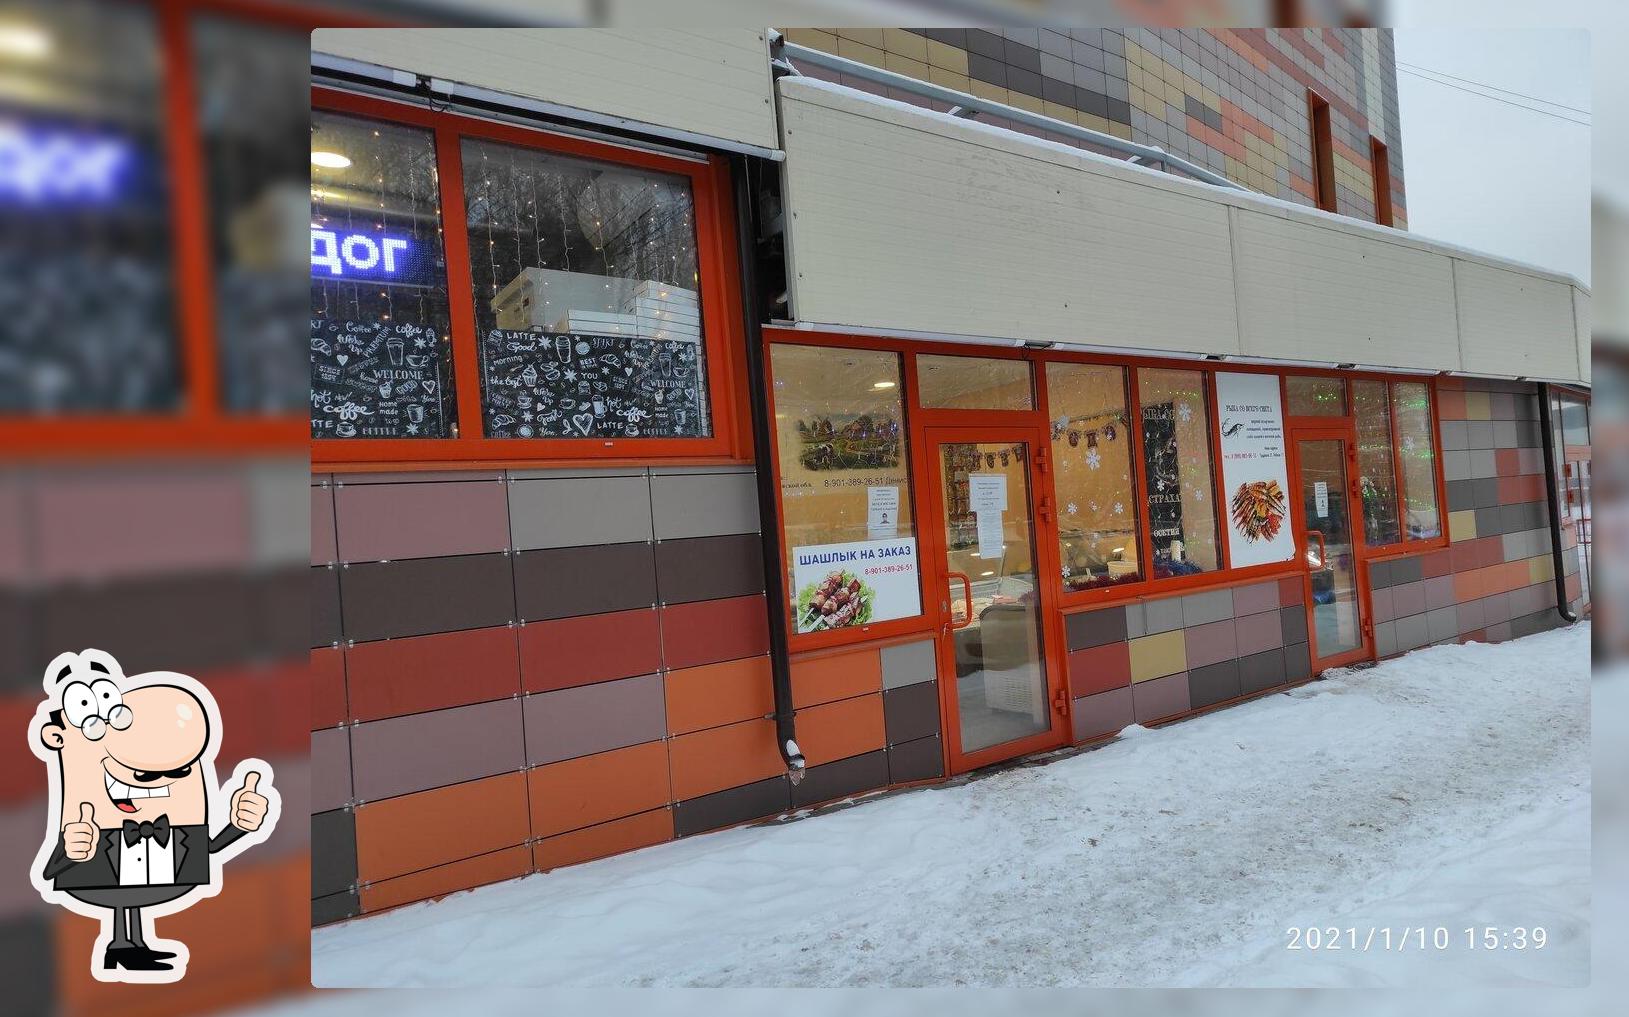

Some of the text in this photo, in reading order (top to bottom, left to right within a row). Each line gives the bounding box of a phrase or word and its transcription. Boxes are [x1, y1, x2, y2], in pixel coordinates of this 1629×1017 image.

[506, 332, 537, 341] LATTE
[373, 370, 424, 380] WELCOME
[581, 372, 598, 380] YOU
[649, 379, 687, 389] WELCOME
[323, 401, 375, 421] coffee
[616, 407, 653, 423] coffee
[597, 421, 624, 430] LATTE
[799, 545, 912, 566] ШАШЛЫК НА ЗАКАЗ
[864, 564, 913, 575] 8-901-389-26-51
